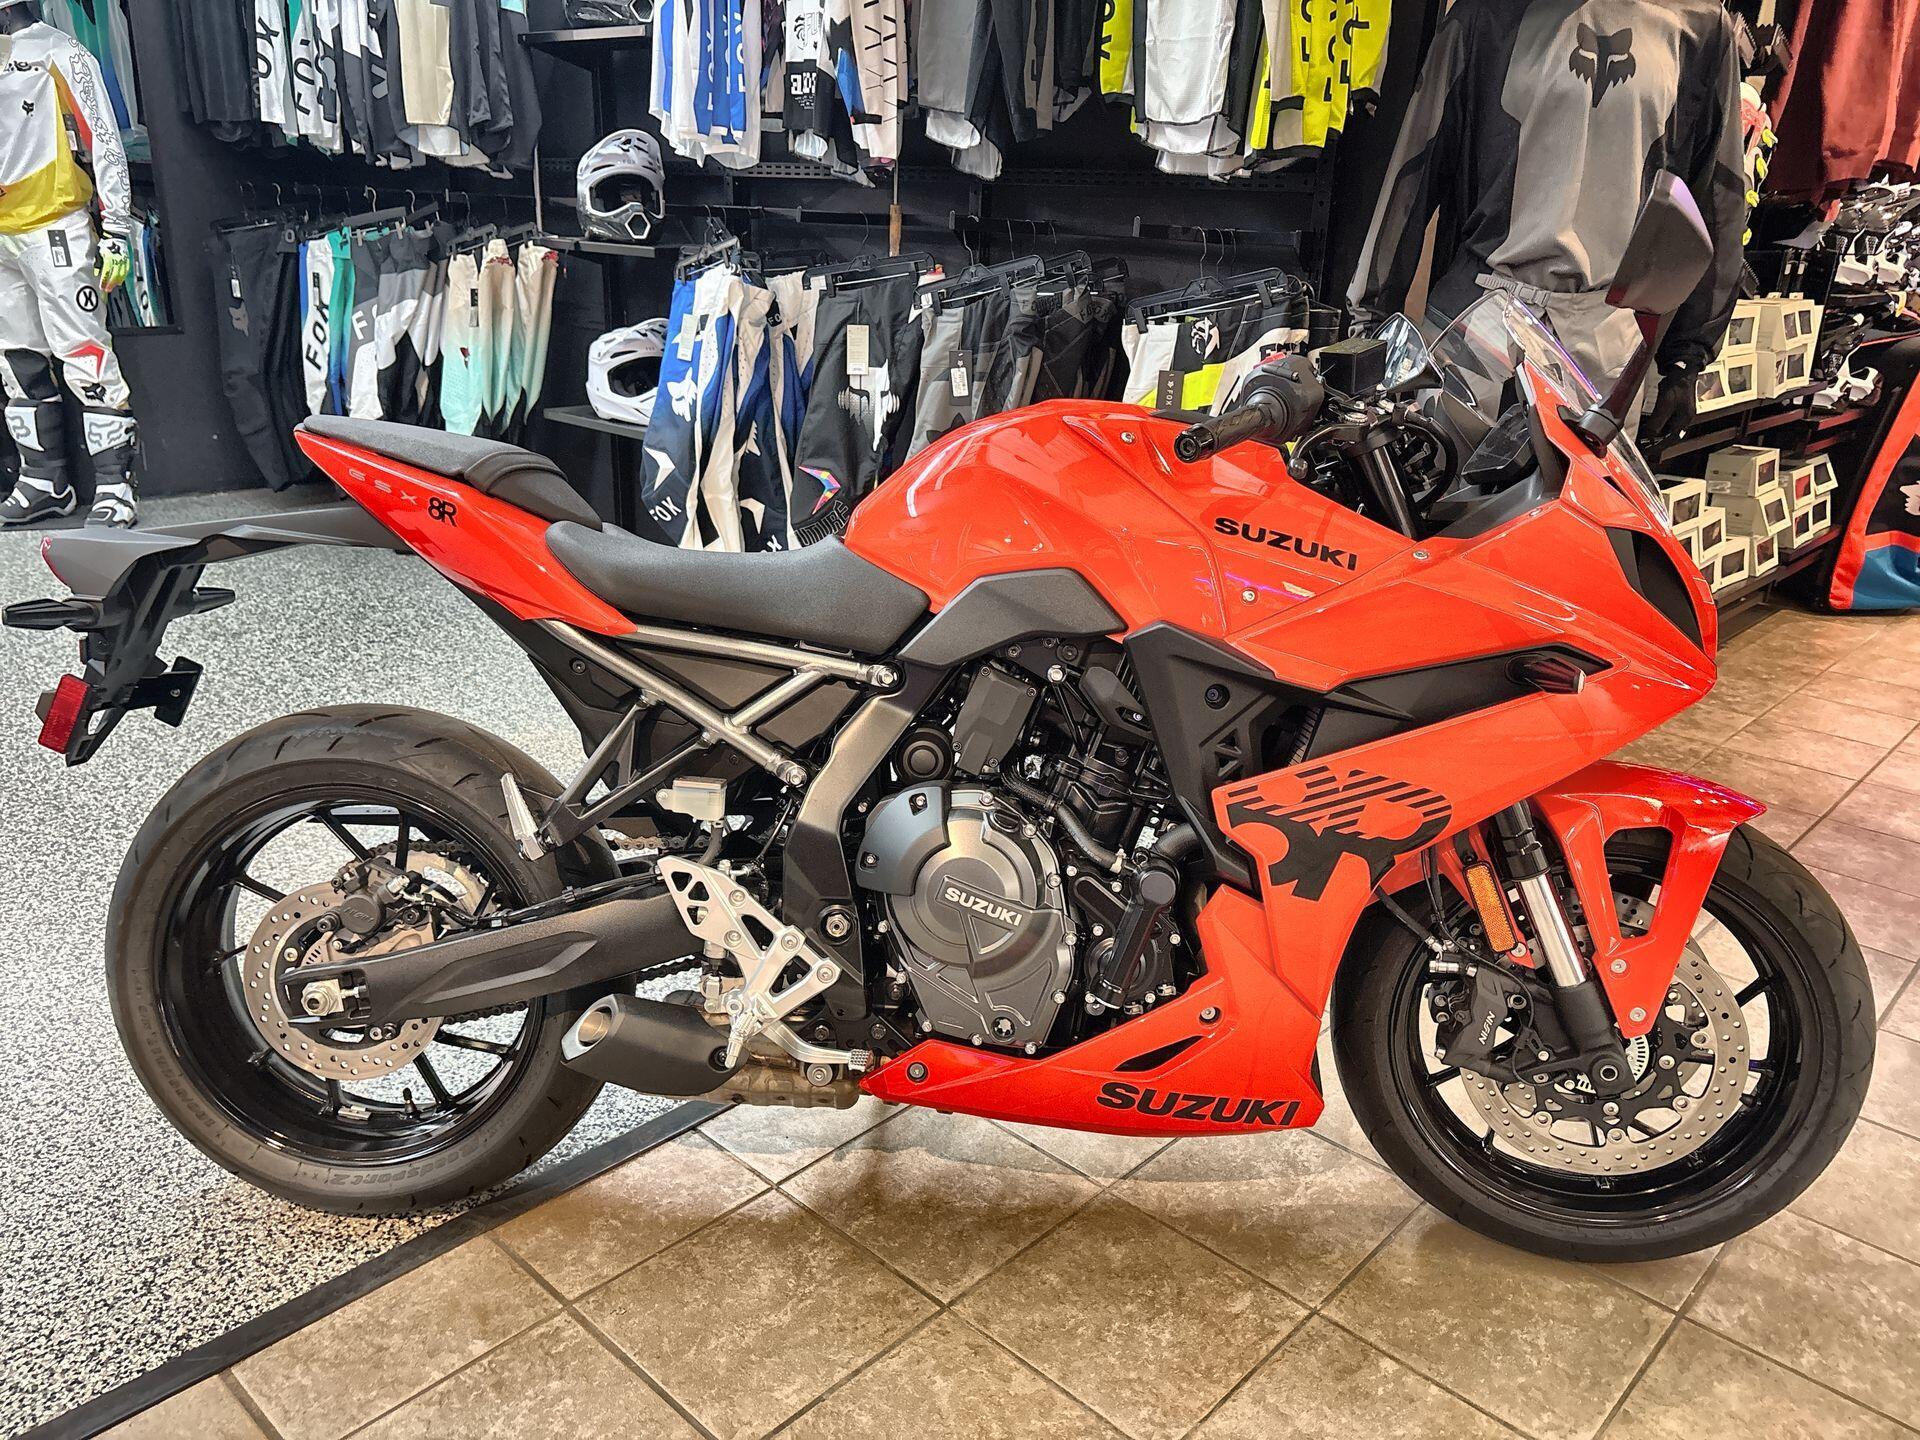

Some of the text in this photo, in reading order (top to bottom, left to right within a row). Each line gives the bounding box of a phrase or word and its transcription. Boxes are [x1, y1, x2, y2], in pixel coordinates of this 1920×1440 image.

[427, 496, 458, 527] 8R
[1214, 517, 1358, 571] SUZUKI
[944, 887, 1023, 927] SUZUKI
[1478, 1010, 1496, 1045] NISSIN
[1096, 1082, 1301, 1126] SUZUKI
